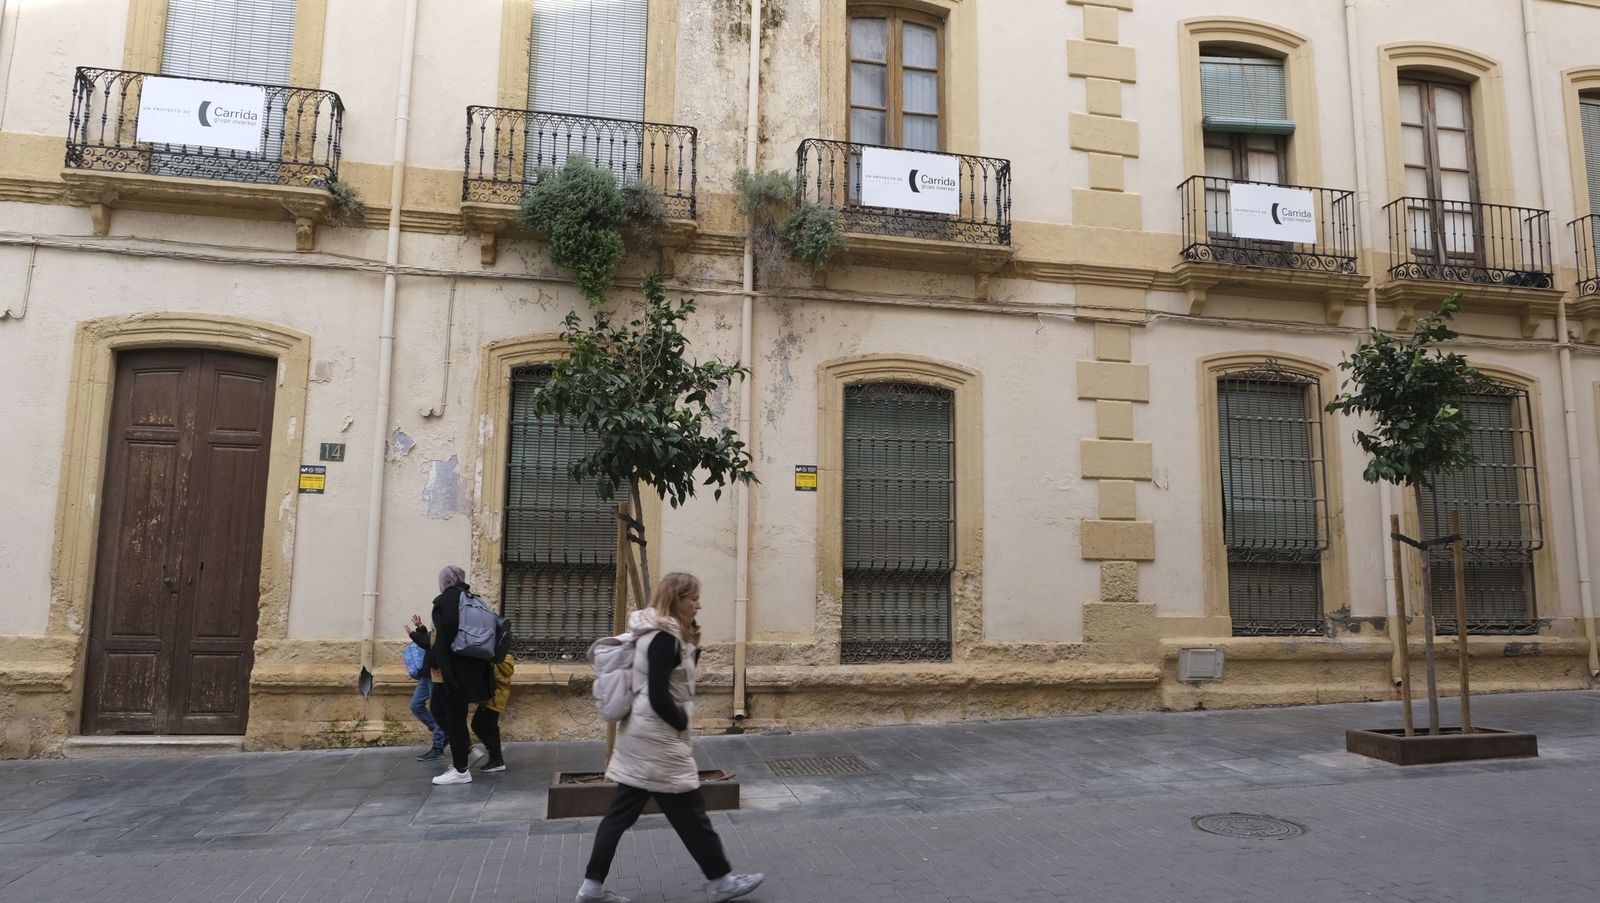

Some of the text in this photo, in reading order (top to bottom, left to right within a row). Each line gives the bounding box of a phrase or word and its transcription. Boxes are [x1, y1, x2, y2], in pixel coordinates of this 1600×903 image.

[214, 107, 258, 120] Carrida
[921, 174, 956, 187] Carrida
[1281, 207, 1312, 219] Carrida
[324, 443, 342, 460] 14
